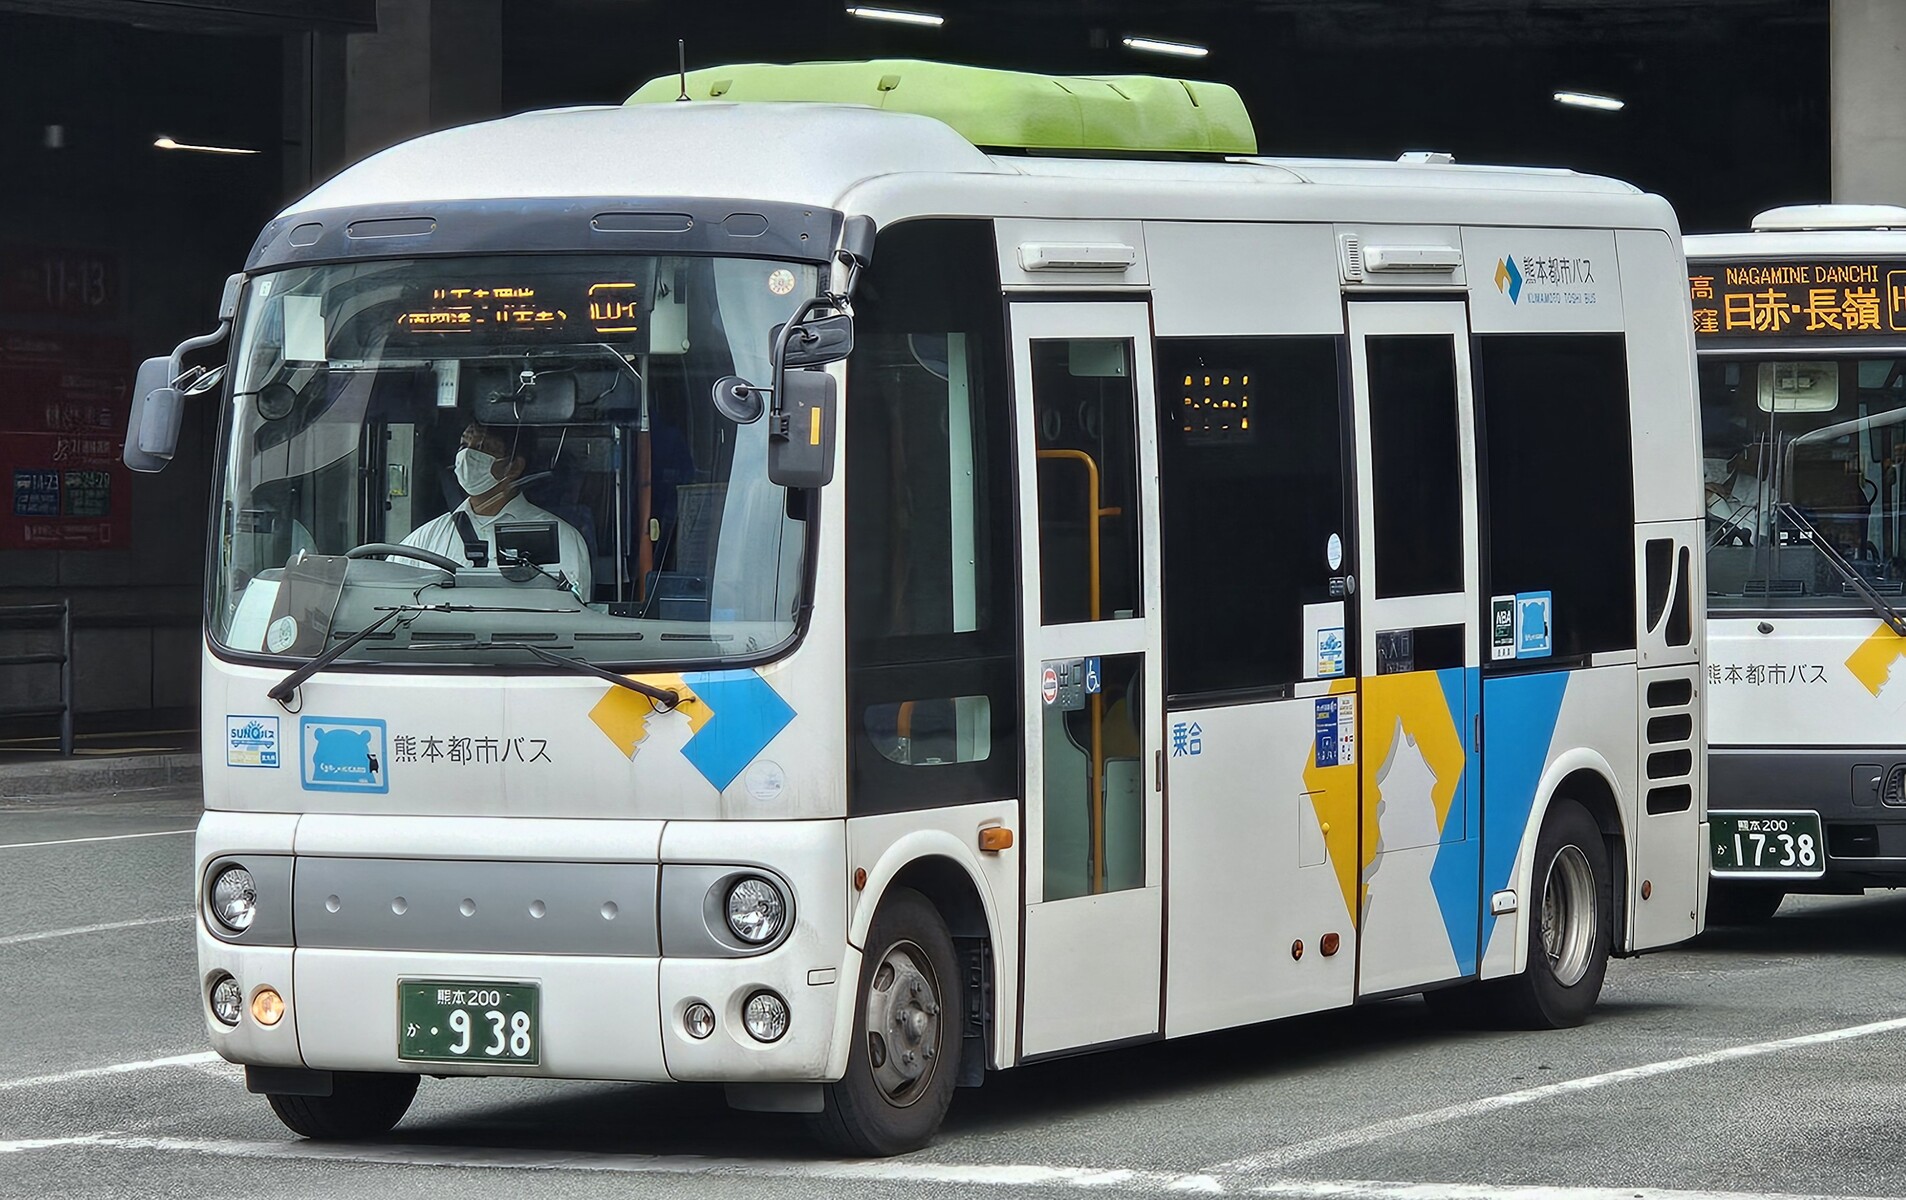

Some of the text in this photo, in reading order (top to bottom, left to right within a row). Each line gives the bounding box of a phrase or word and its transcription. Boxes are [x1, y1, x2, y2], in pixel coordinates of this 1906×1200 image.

[1523, 256, 1595, 286] 熊本都市バス
[1725, 265, 1879, 285] NAGAMINE DANCHI
[1708, 663, 1828, 686] 熊本都市バス
[394, 735, 552, 766] 熊本都市バス
[1173, 721, 1202, 757] 乗合
[1734, 833, 1816, 867] 17-38
